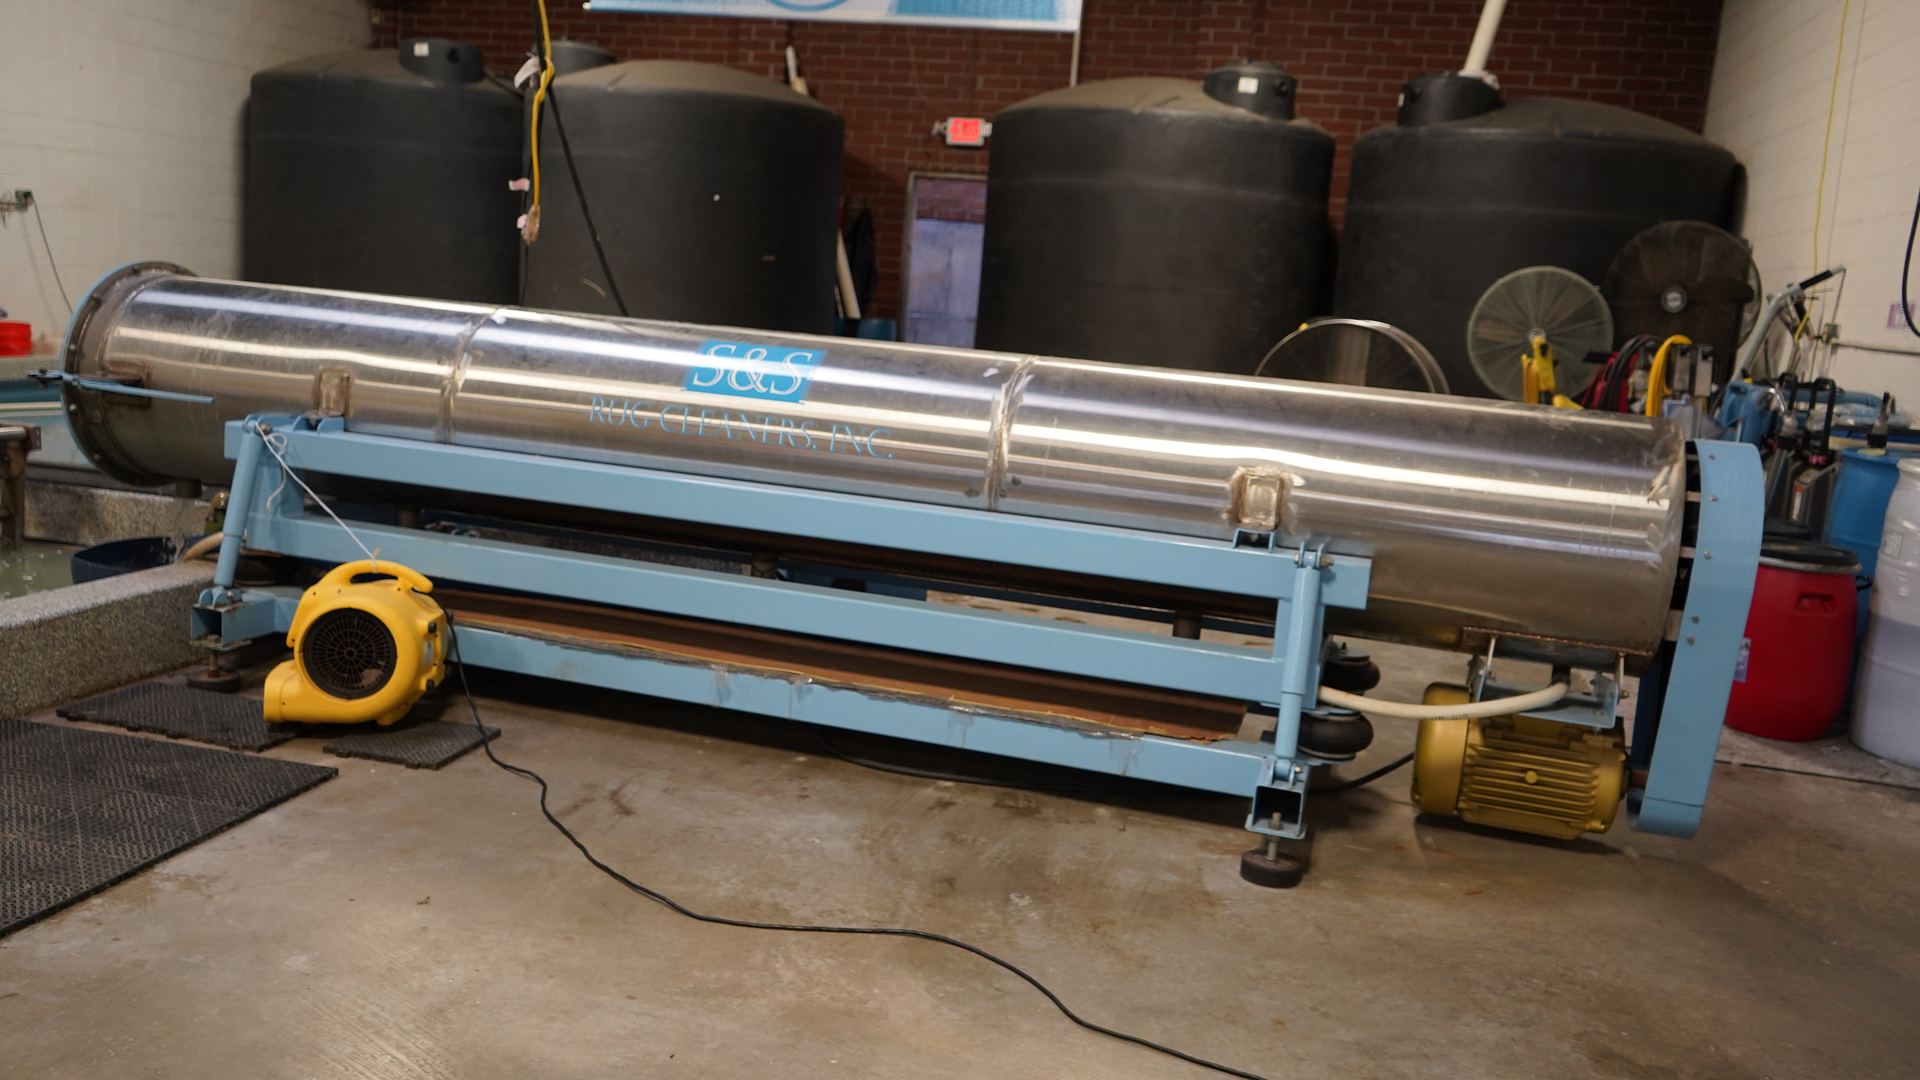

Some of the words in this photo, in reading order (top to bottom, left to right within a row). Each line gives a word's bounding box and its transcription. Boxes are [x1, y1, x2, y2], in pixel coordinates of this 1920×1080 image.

[692, 343, 814, 395] S&S
[590, 396, 650, 429] RUG
[829, 423, 894, 459] INC.
